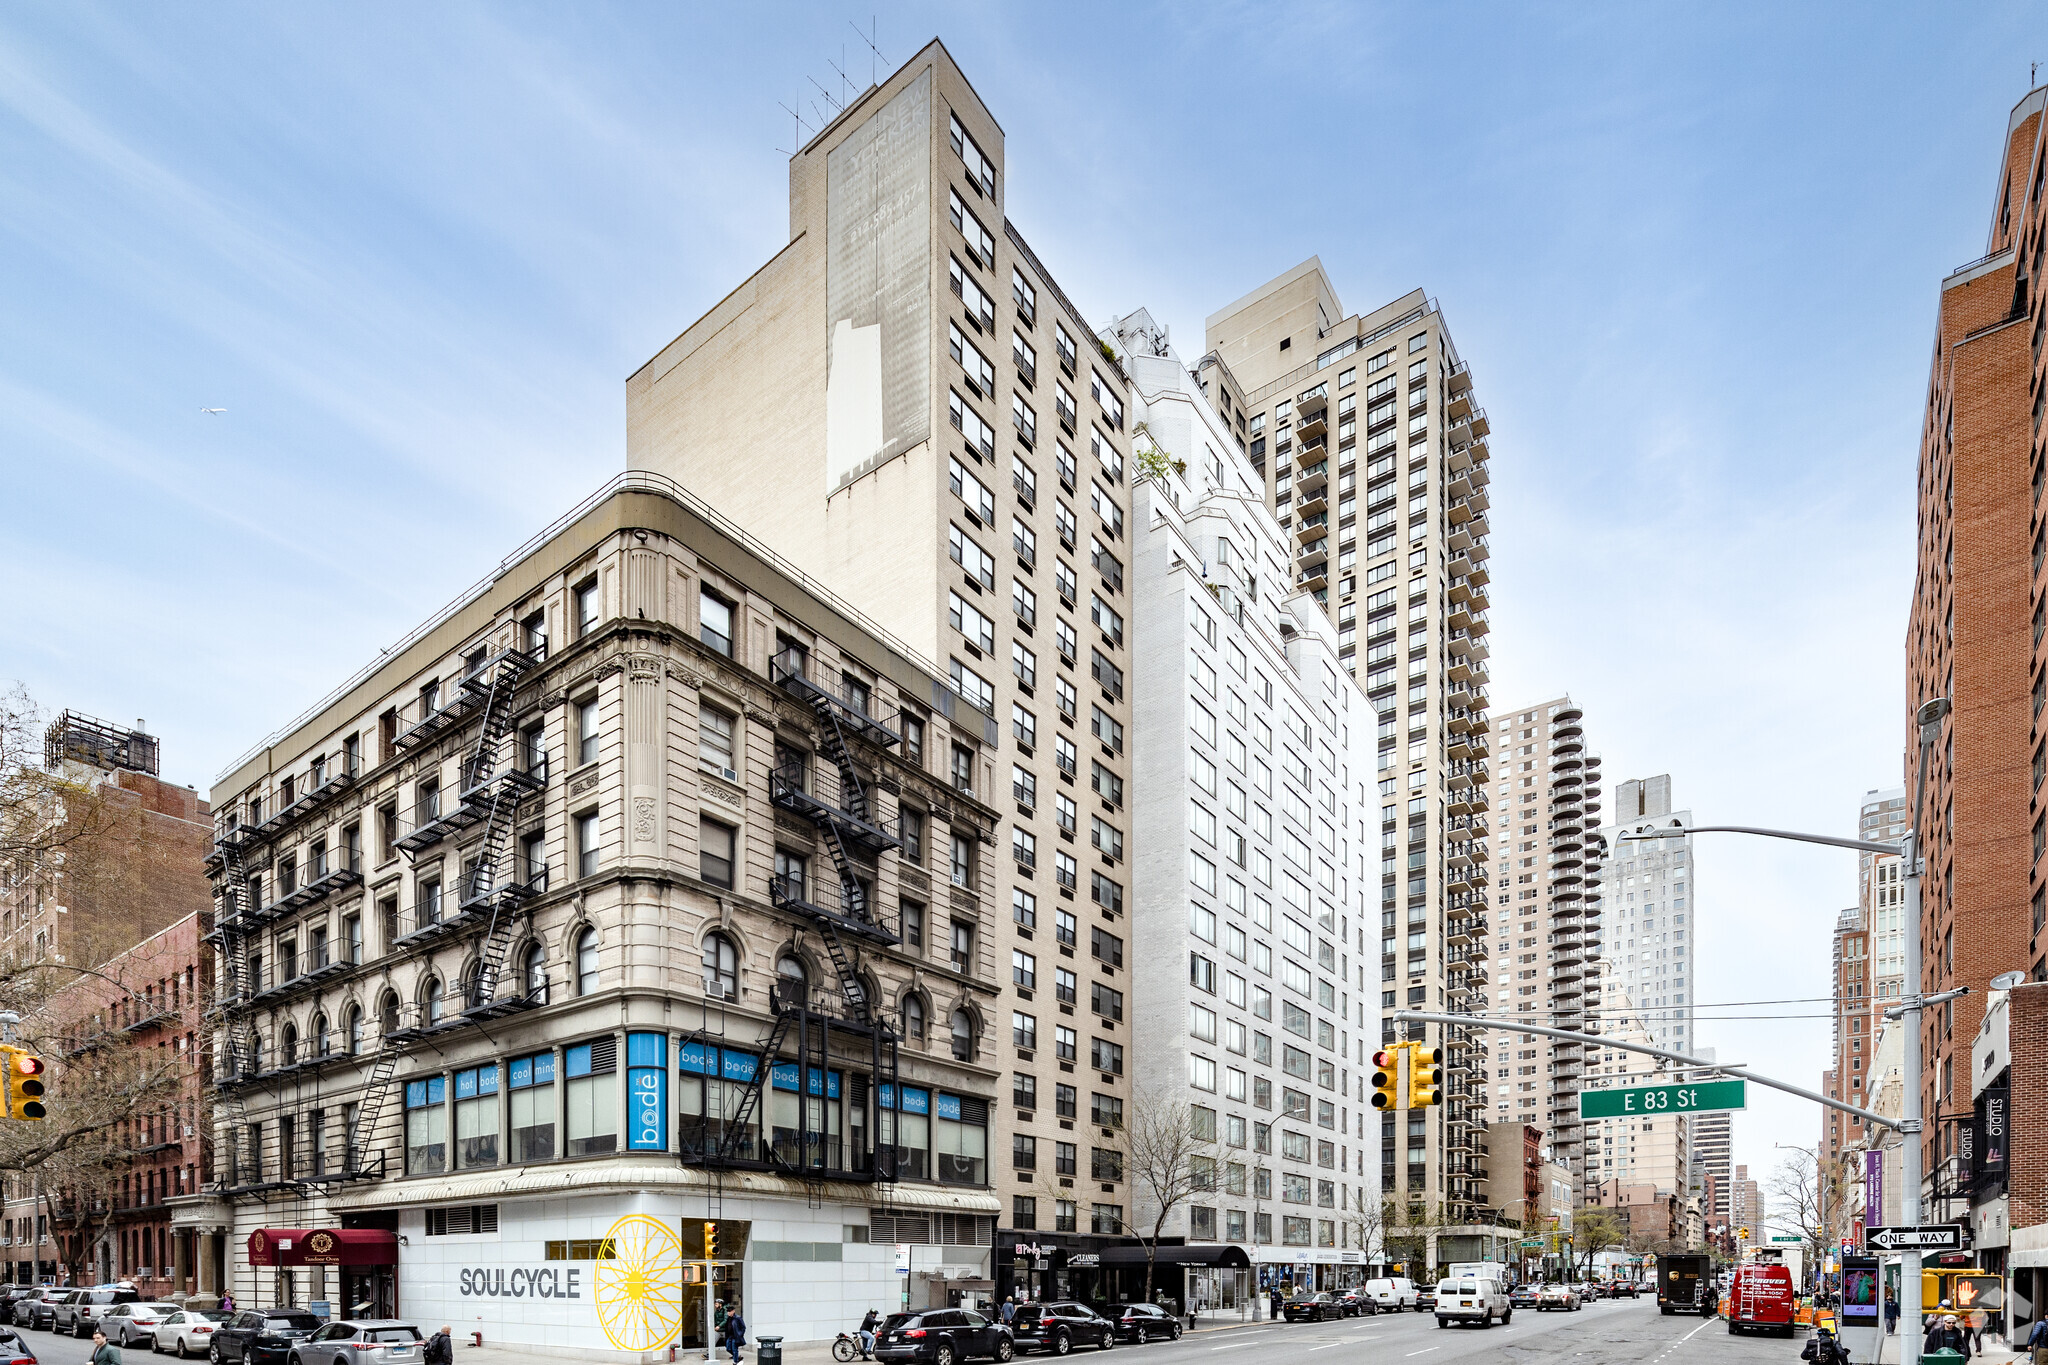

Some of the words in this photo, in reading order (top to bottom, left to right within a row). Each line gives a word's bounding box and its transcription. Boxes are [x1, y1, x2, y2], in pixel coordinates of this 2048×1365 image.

[882, 84, 925, 131] NEW
[850, 101, 925, 170] YORKER
[838, 120, 925, 193] CONDOMINIUM
[460, 1078, 473, 1091] hot
[512, 1065, 531, 1080] cool
[1624, 1093, 1636, 1111] E
[1644, 1091, 1668, 1110] 83
[1677, 1089, 1698, 1108] St
[1991, 1098, 2003, 1137] STUDIO
[1963, 1127, 1973, 1160] STUDIO
[1022, 1241, 1041, 1260] Pinky
[1879, 1234, 1906, 1244] ONE
[1918, 1232, 1948, 1243] WAY
[1076, 1253, 1100, 1262] CLEANERS
[460, 1267, 581, 1299] SOULCYCLE
